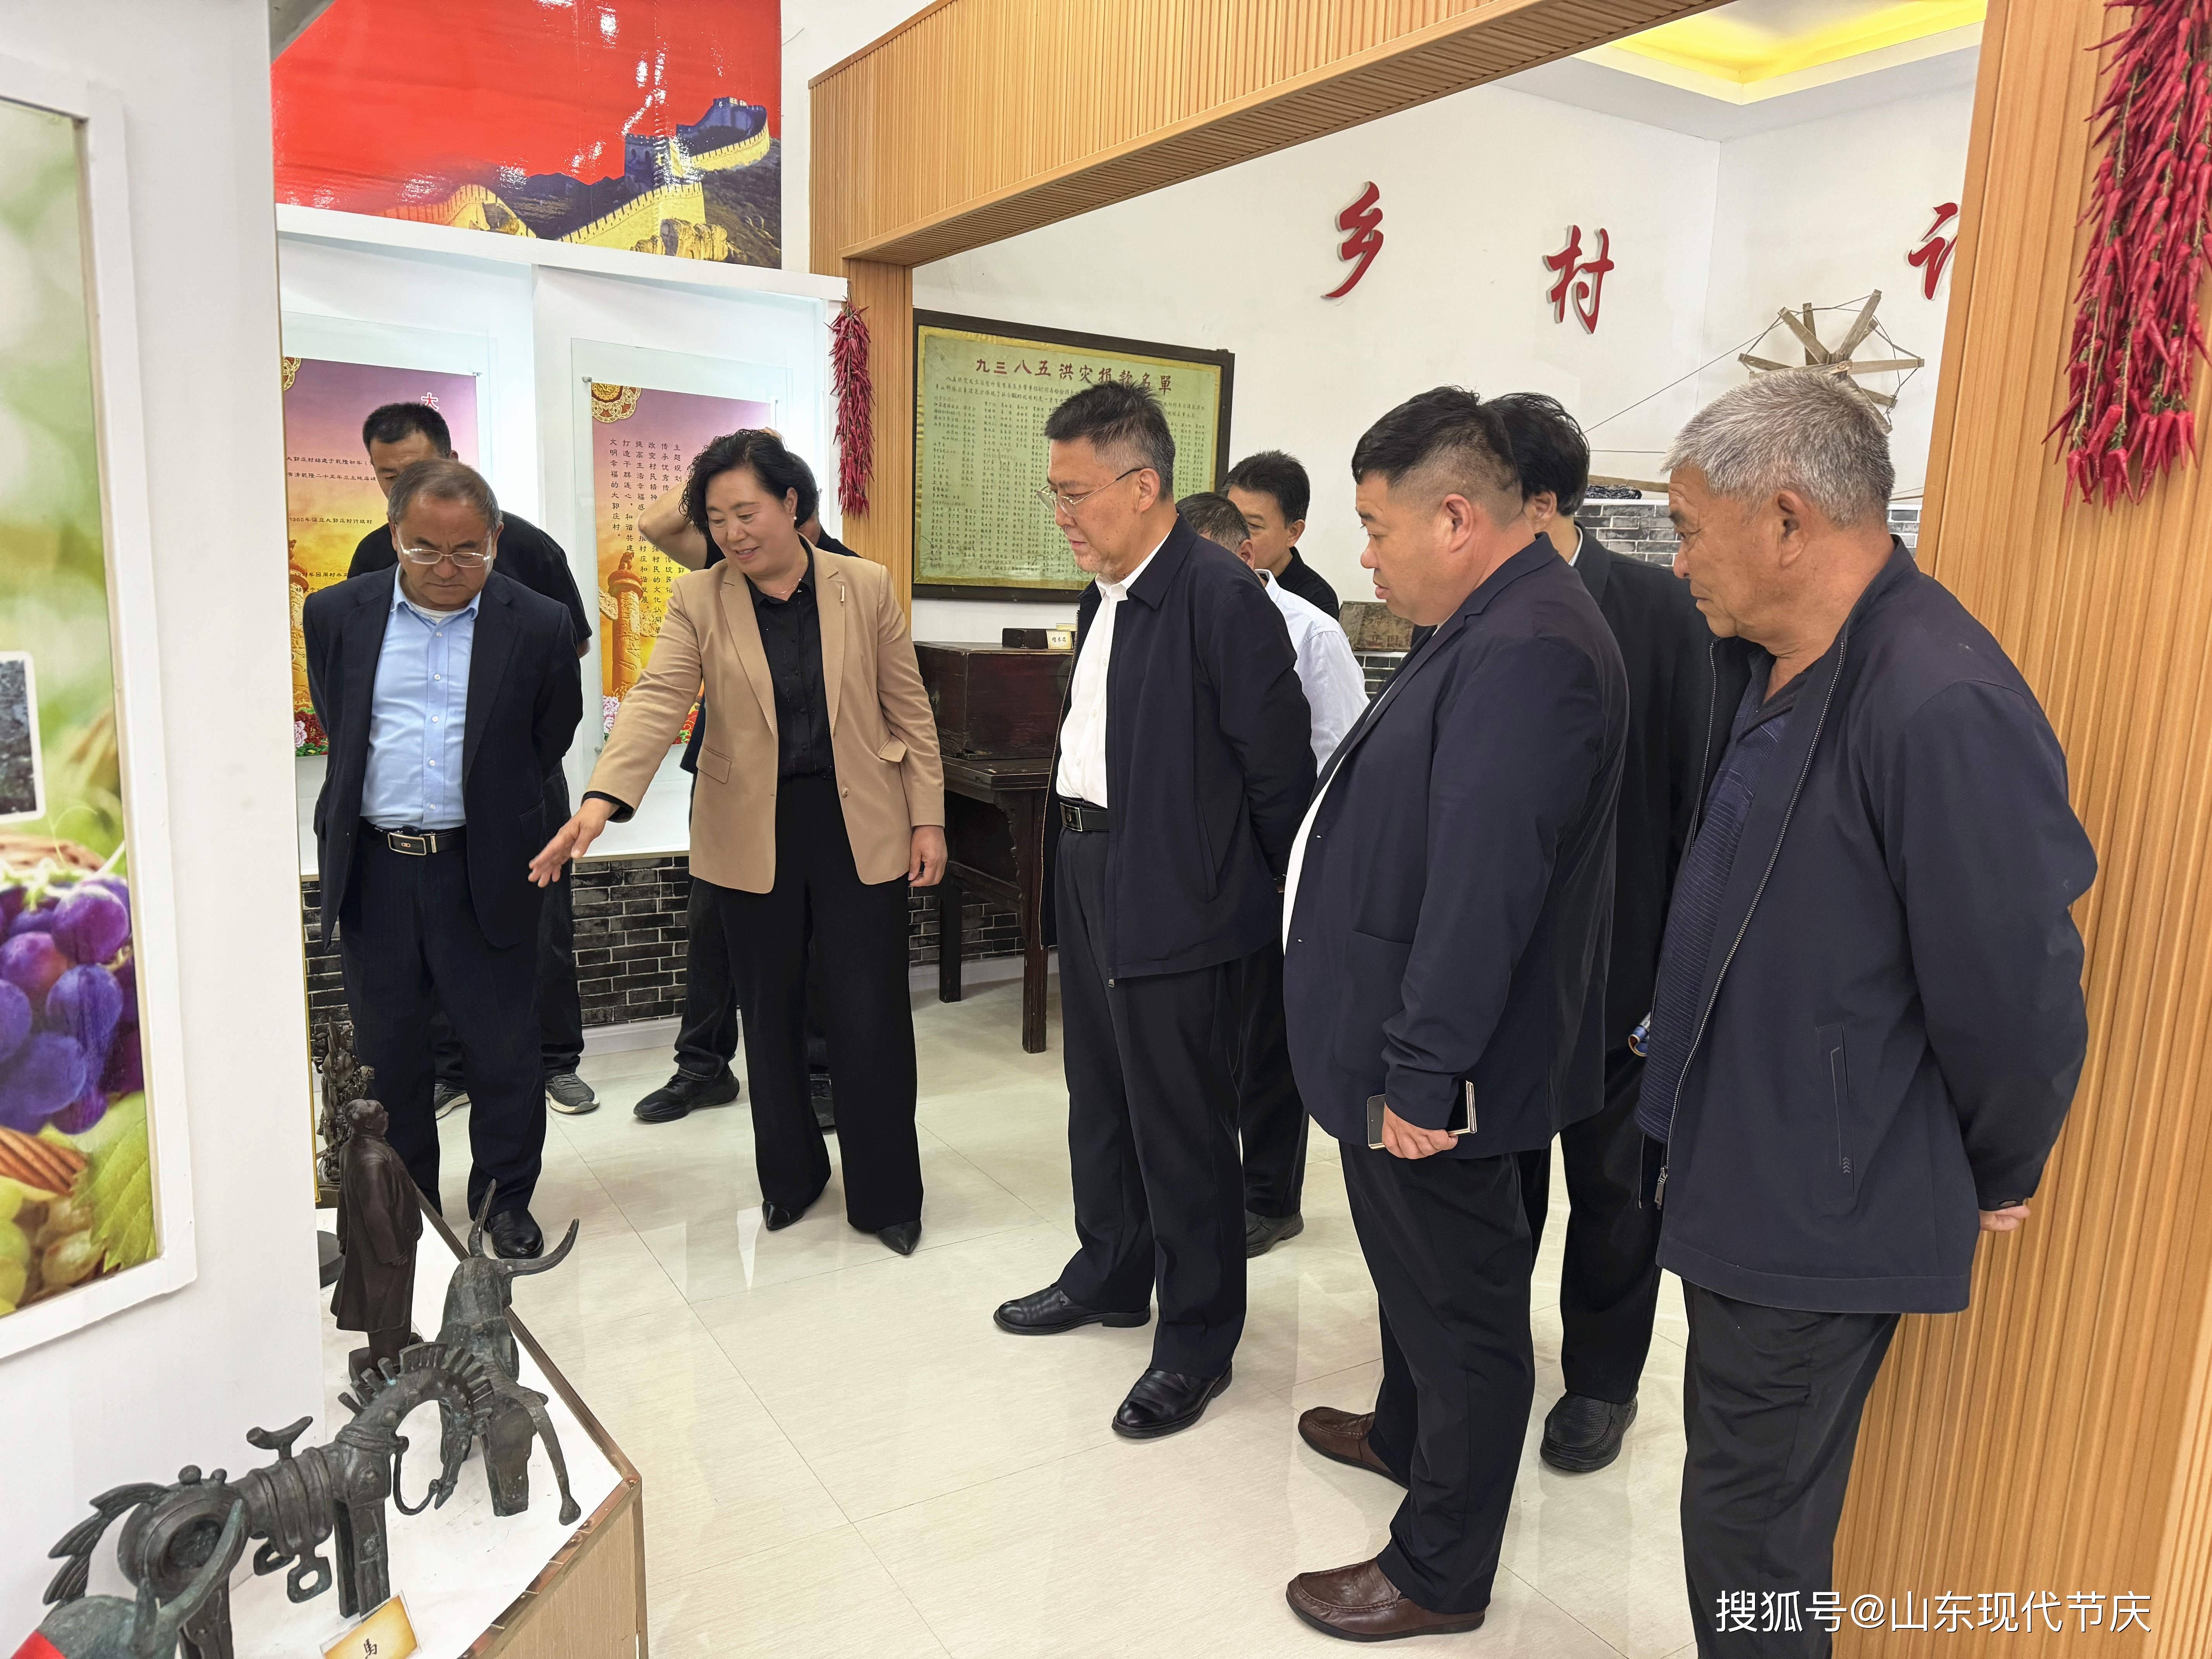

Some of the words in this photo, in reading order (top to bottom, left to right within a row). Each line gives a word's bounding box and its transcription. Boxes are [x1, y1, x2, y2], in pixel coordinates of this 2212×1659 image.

[635, 441, 645, 510] 提高生活幸福感
[648, 442, 658, 501] 改变村民精神
[661, 443, 670, 491] 传承优秀传
